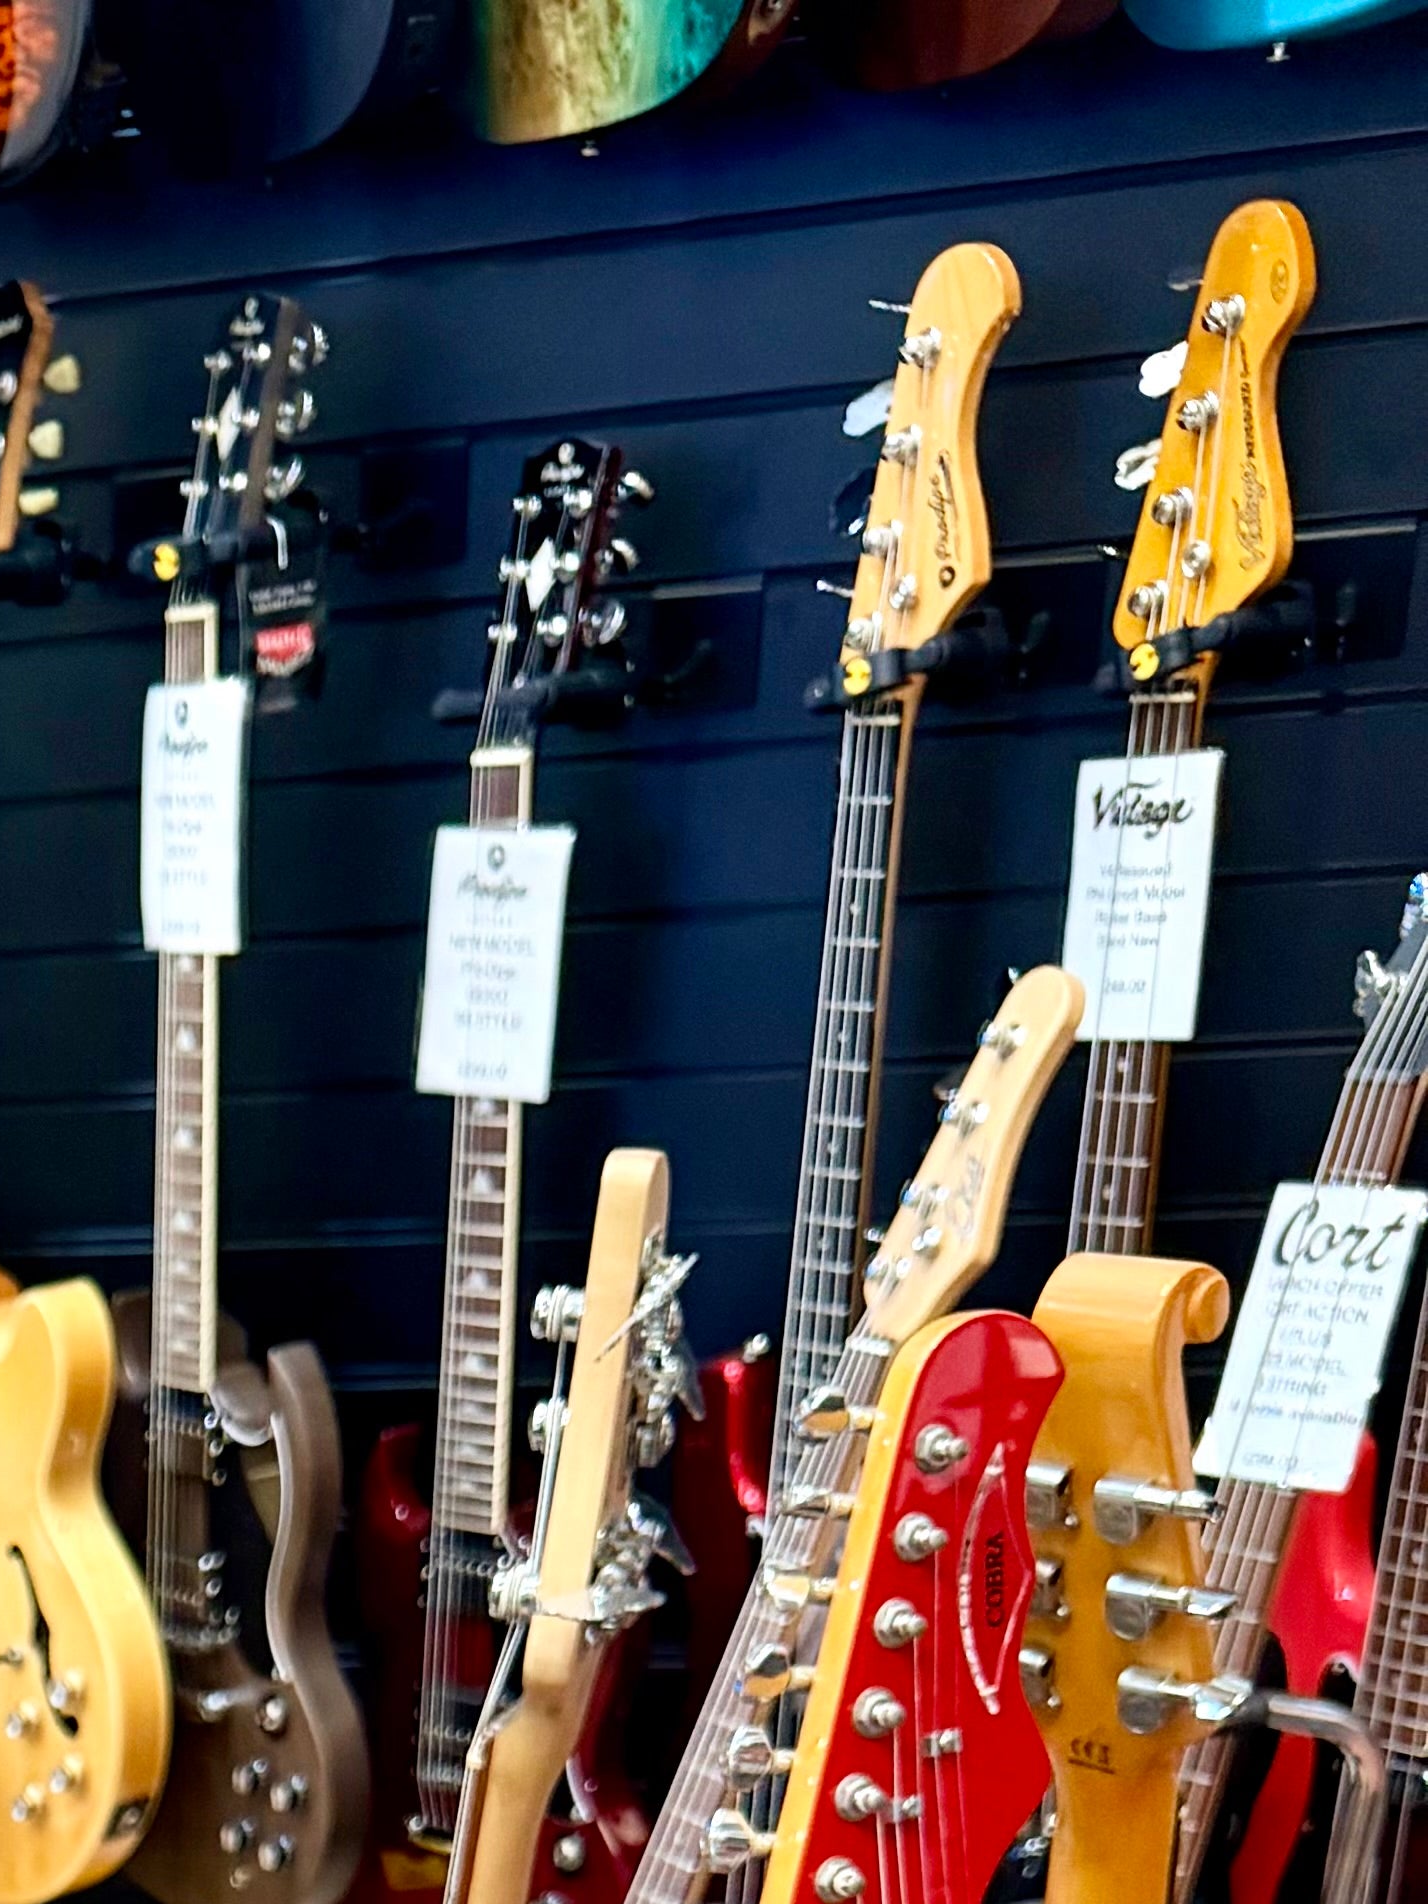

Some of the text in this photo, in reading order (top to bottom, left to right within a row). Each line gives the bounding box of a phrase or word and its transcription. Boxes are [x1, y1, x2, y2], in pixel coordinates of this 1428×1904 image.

[1093, 779, 1194, 840] Vintage
[1272, 1199, 1406, 1273] Cort
[985, 1530, 1005, 1627] COBRA
